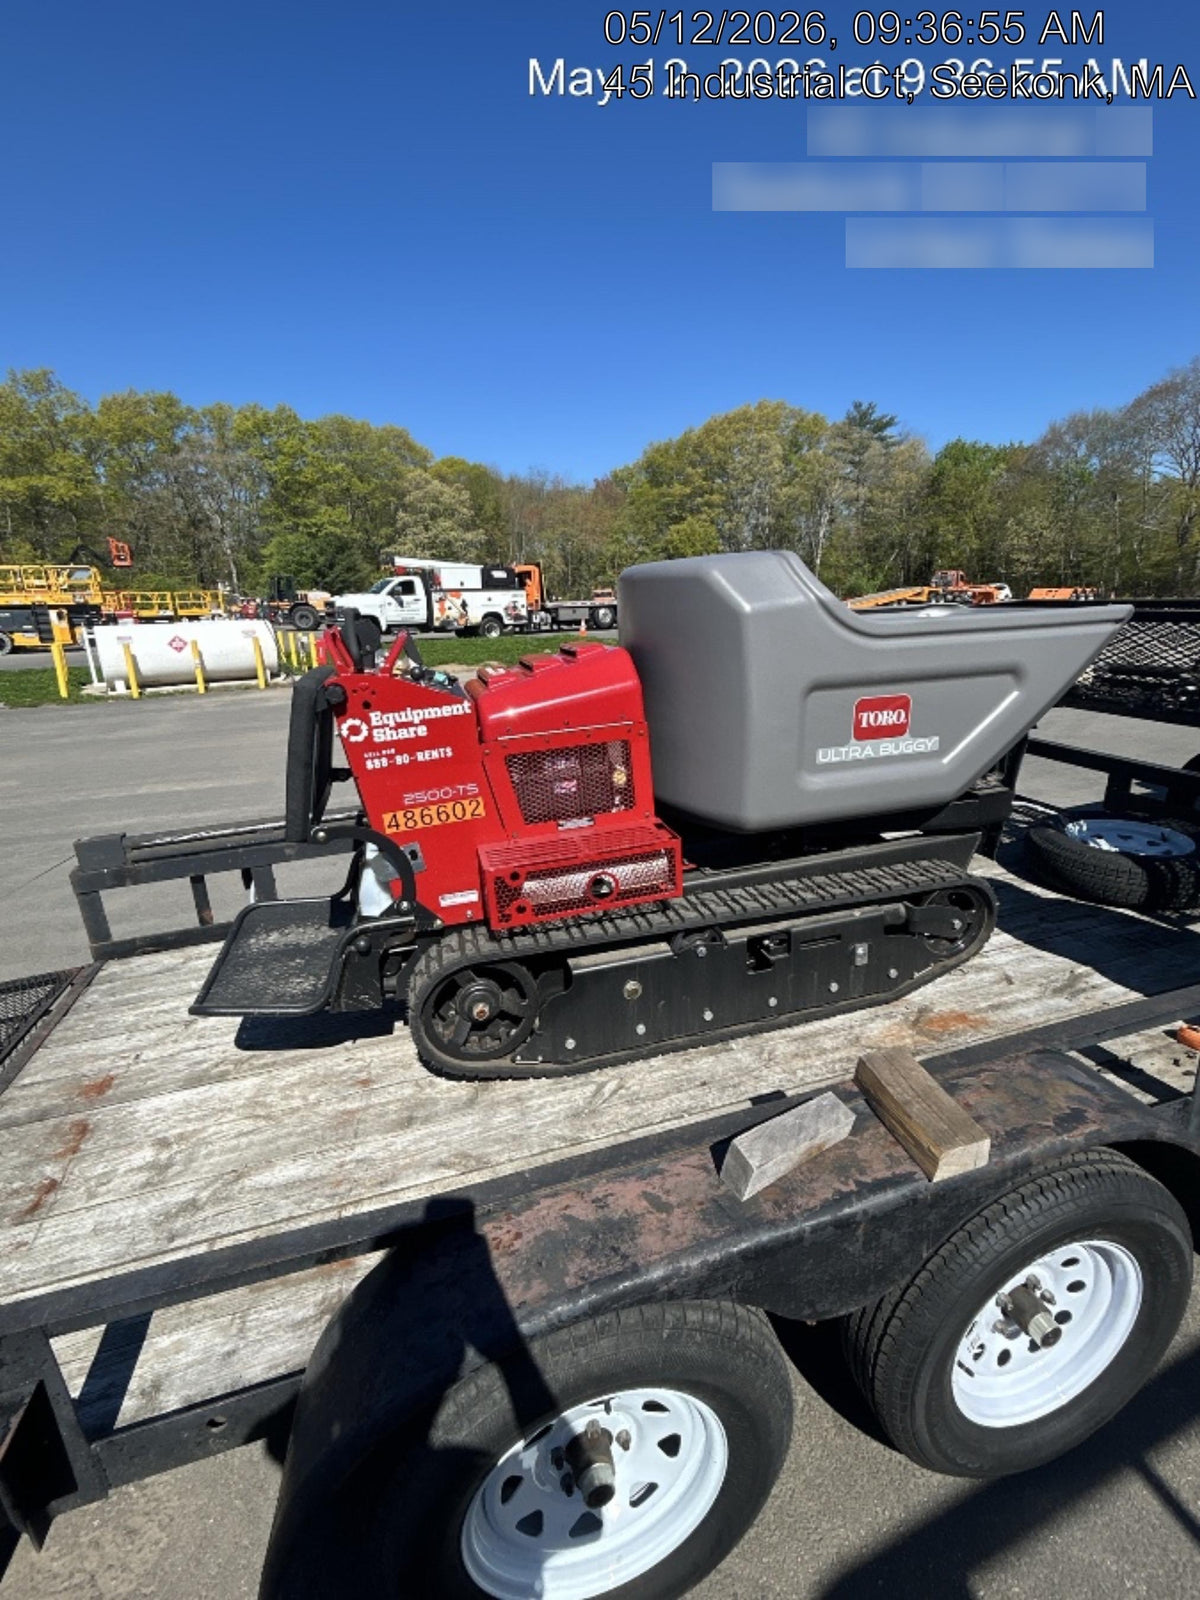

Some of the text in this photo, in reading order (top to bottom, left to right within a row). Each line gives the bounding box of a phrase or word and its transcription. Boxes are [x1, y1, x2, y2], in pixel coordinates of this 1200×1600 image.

[369, 700, 472, 728] Equipment
[858, 708, 907, 728] TORO
[372, 725, 428, 742] Share
[818, 739, 935, 763] ULTRA BUGGY
[403, 783, 479, 806] 2500-TS
[386, 799, 482, 831] 486602
